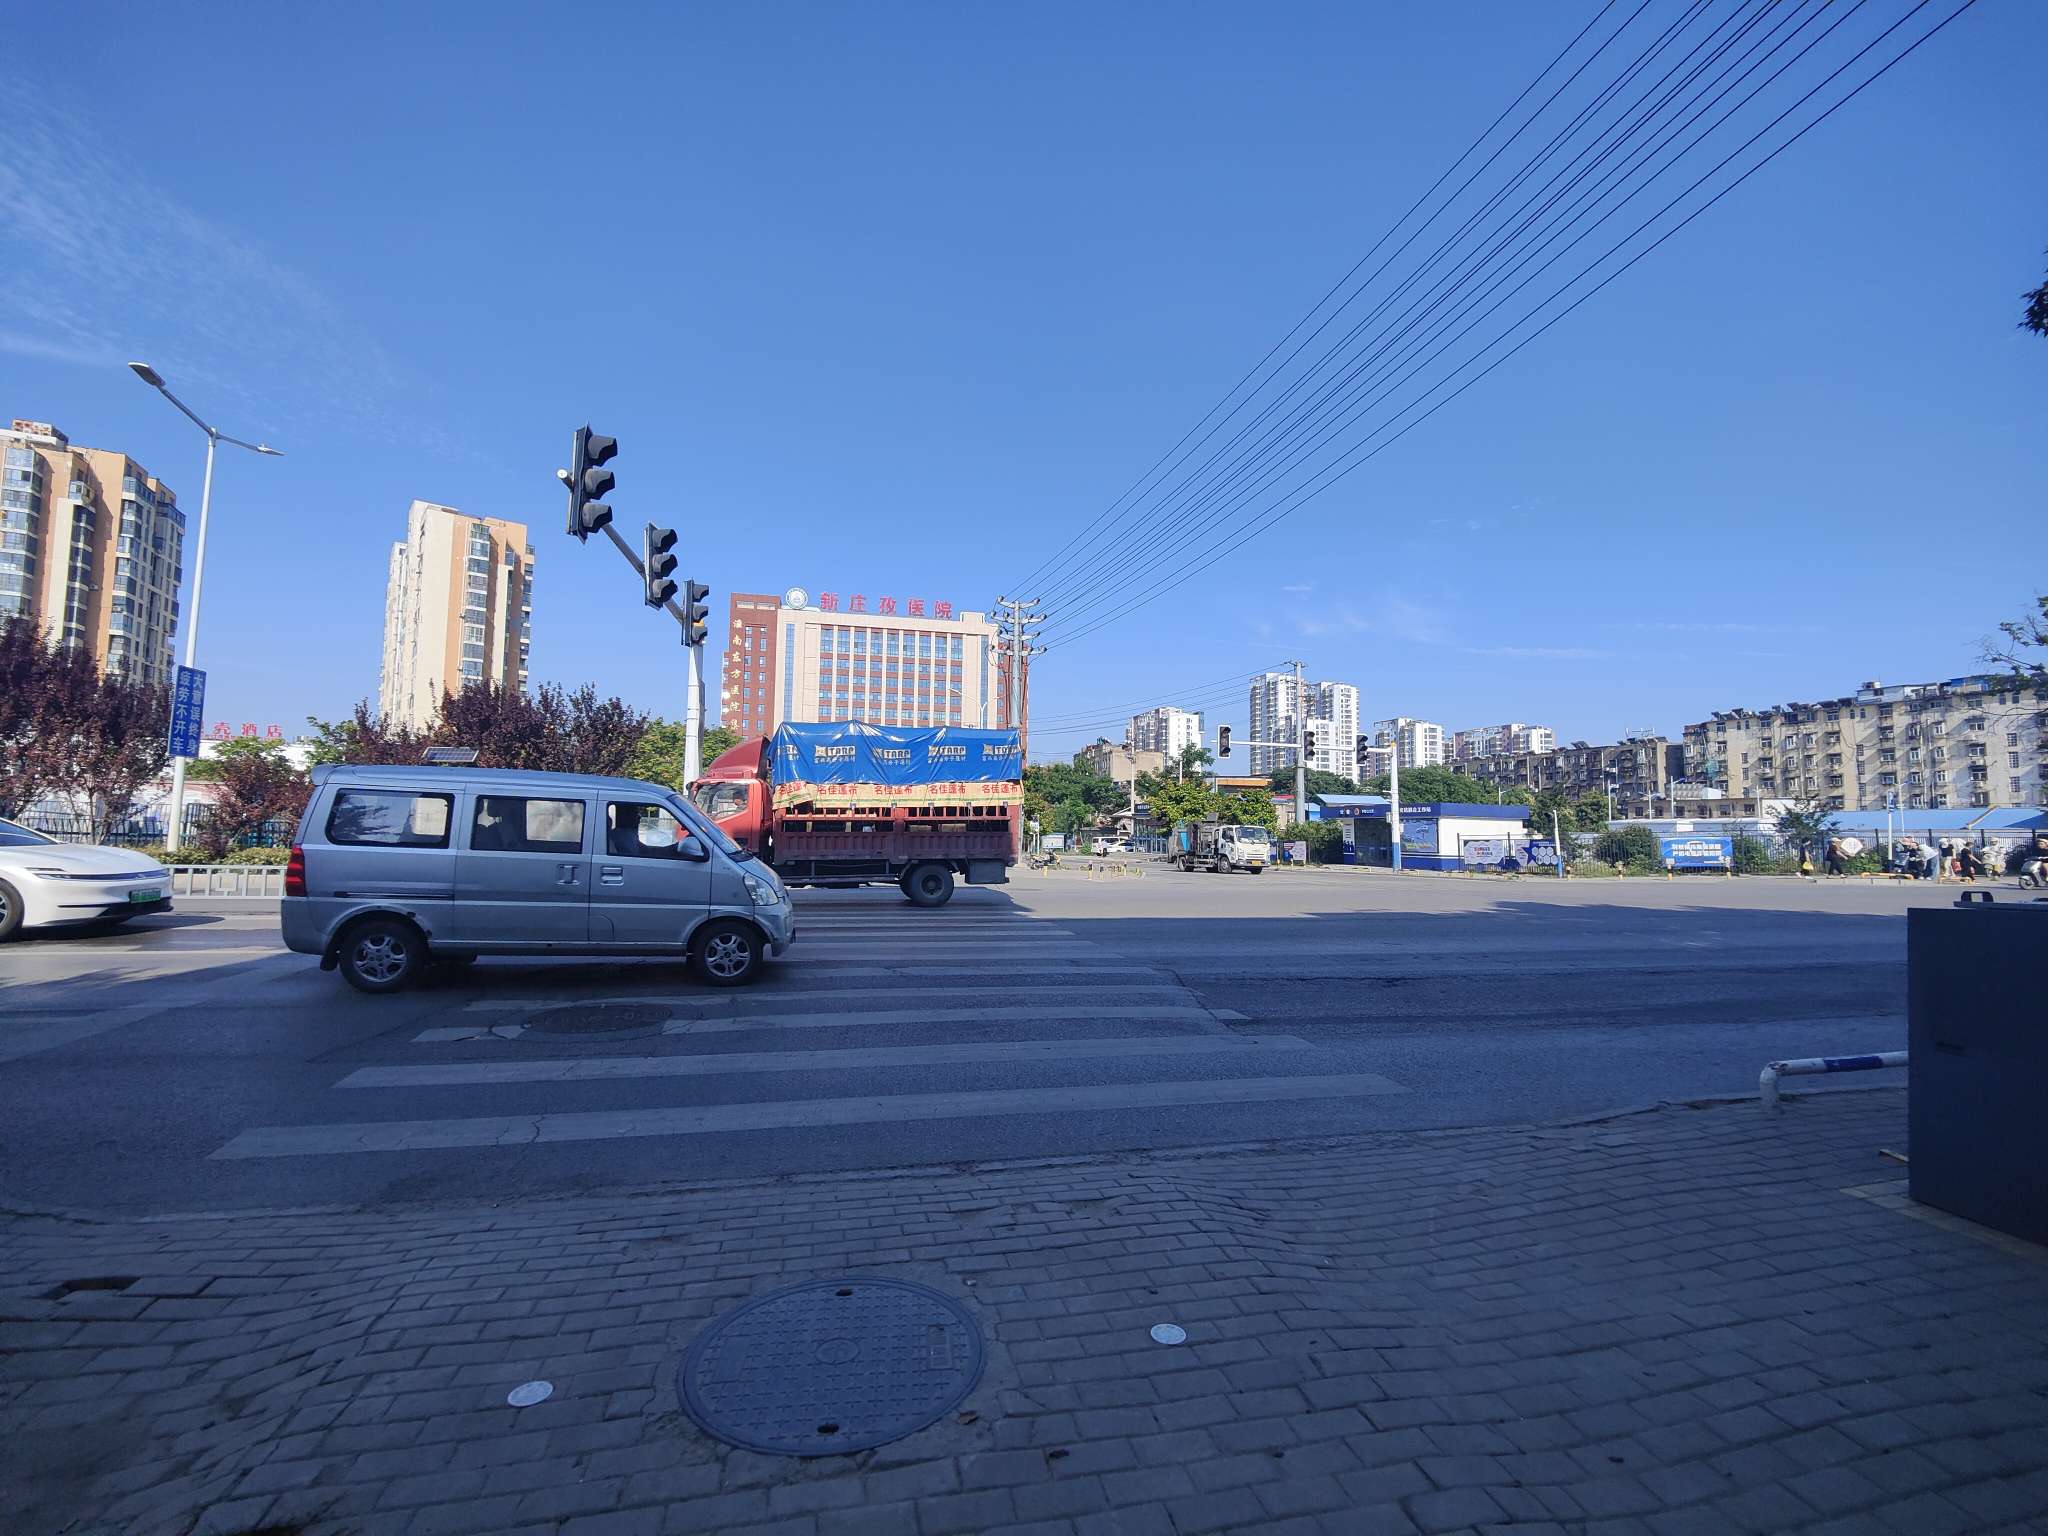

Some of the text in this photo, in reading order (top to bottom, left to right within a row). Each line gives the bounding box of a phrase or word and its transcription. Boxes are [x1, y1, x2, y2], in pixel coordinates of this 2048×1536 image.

[820, 591, 952, 618] 新庄孜医院
[173, 670, 191, 751] 疲劳不开车
[186, 673, 203, 753] 大意误终身
[201, 721, 282, 738] 壳酒店
[828, 747, 854, 755] TARP
